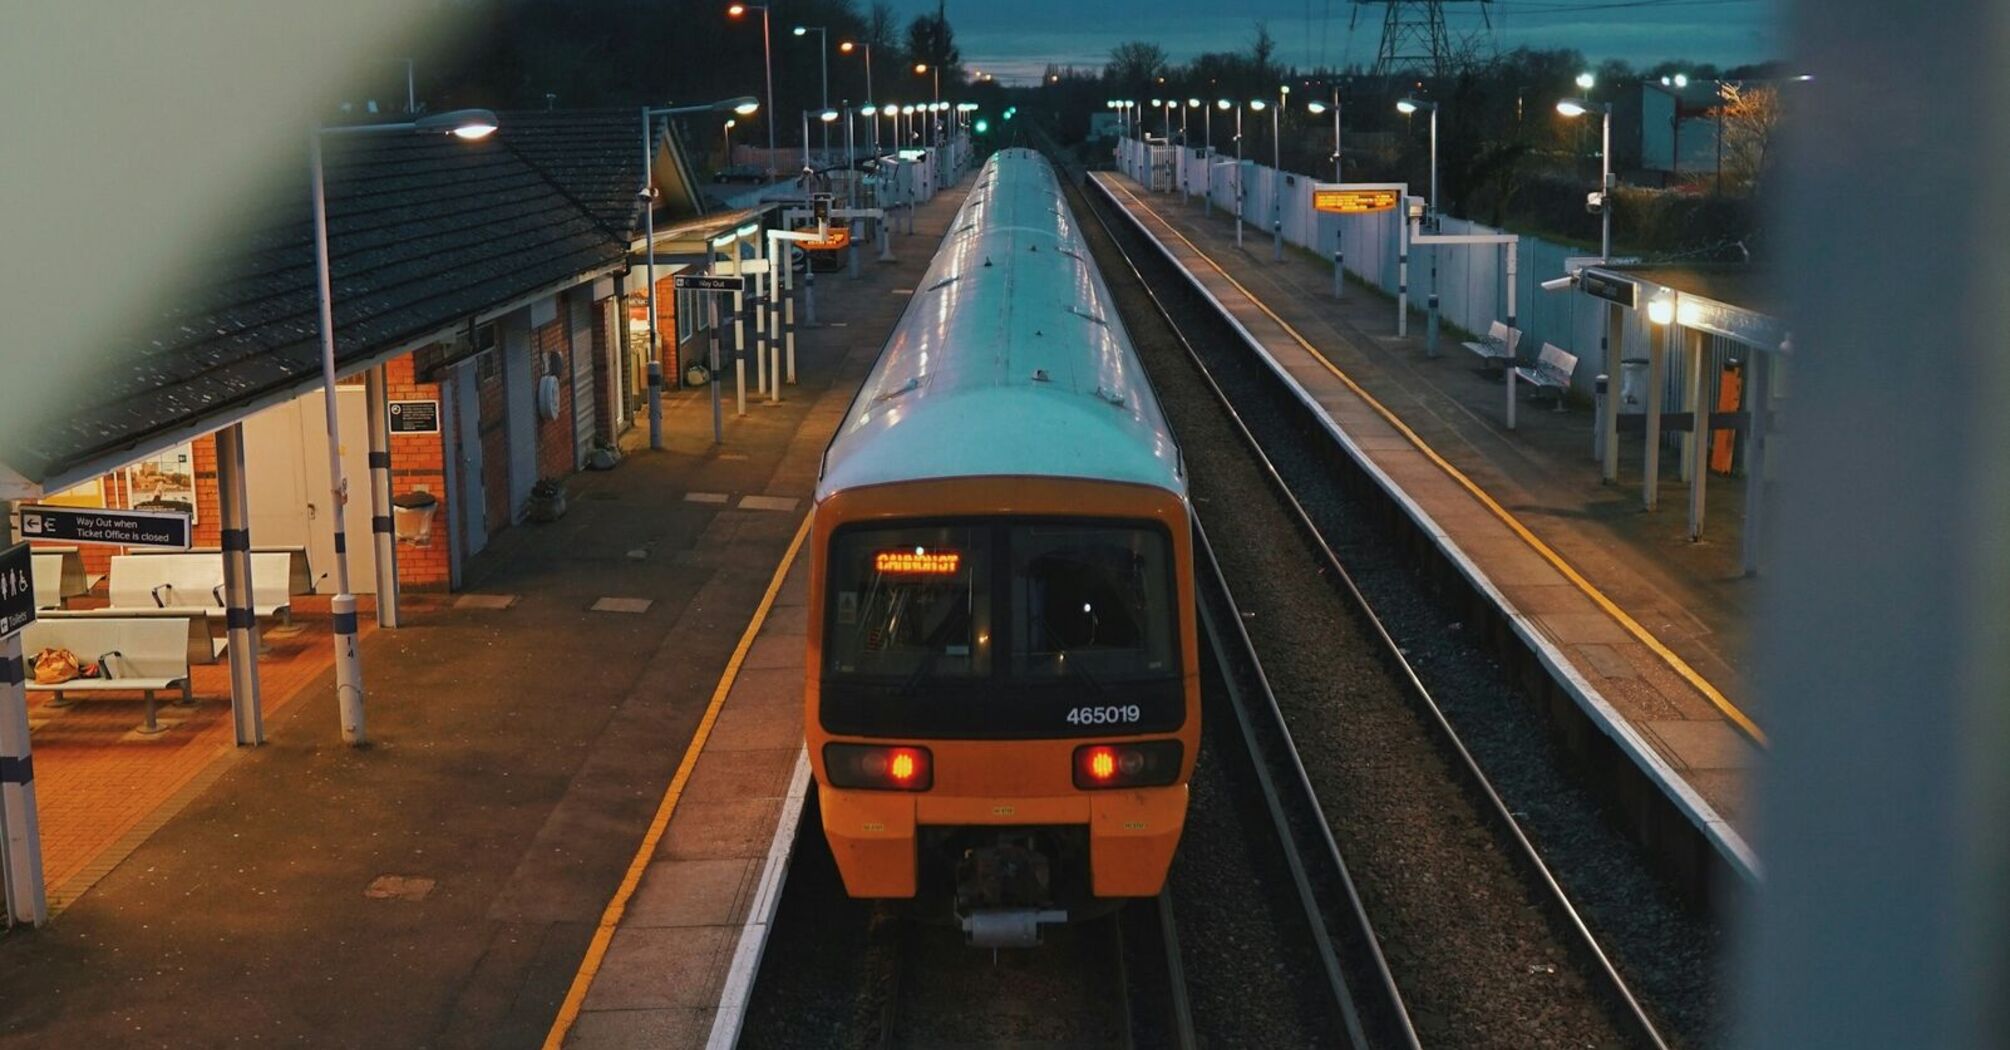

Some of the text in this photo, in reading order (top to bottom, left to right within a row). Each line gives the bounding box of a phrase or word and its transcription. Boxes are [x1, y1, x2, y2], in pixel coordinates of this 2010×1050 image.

[76, 516, 138, 529] Way Out when
[77, 527, 170, 542] Ticket Office is closed
[1066, 704, 1140, 725] 465019
